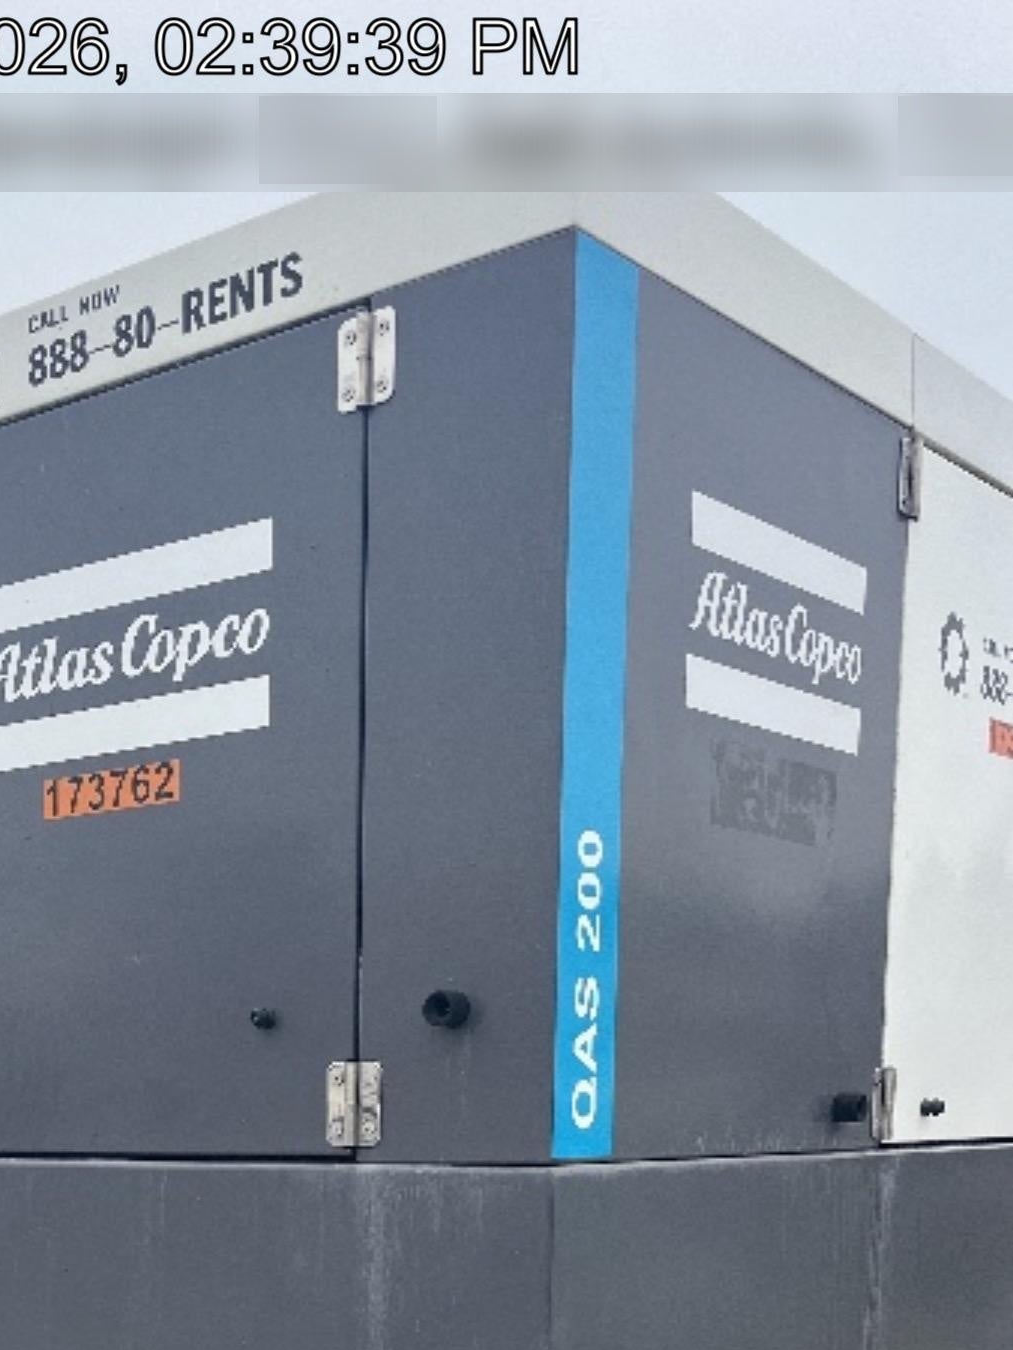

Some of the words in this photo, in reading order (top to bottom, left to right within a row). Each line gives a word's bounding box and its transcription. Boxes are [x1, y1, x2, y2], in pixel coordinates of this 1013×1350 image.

[28, 305, 69, 334] CALL
[79, 284, 121, 316] NOW
[120, 608, 271, 682] Copco
[689, 571, 783, 658] Atlas
[785, 602, 861, 685] Copco
[45, 761, 175, 817] 173762
[575, 829, 604, 952] 200
[571, 976, 600, 1129] QAS
